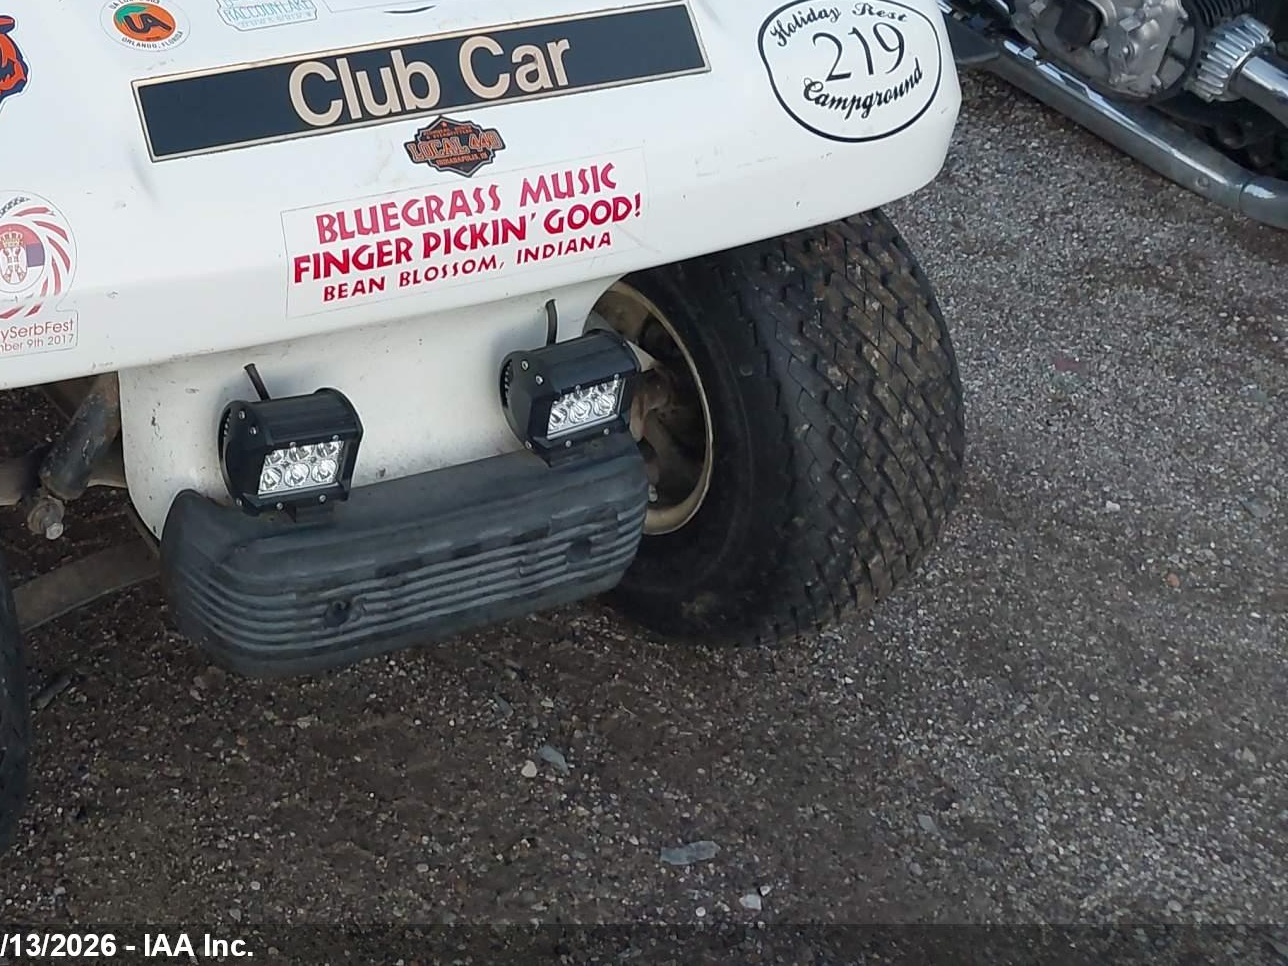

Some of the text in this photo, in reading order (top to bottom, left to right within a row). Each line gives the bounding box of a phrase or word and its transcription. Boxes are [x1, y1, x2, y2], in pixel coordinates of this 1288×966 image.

[123, 13, 173, 33] UA
[770, 2, 909, 47] Holiday Rest
[812, 21, 905, 82] 219
[289, 34, 572, 126] Club Car
[803, 56, 923, 120] Campground
[406, 136, 470, 161] LOCAL
[316, 162, 618, 244] BLUEGRASS MUSIC
[294, 192, 642, 284] FINGER PICKIN' GOOD!
[323, 232, 612, 302] BEAN BLOSSOM, INDIANA
[26, 337, 44, 348] 9th
[47, 334, 75, 346] 2017
